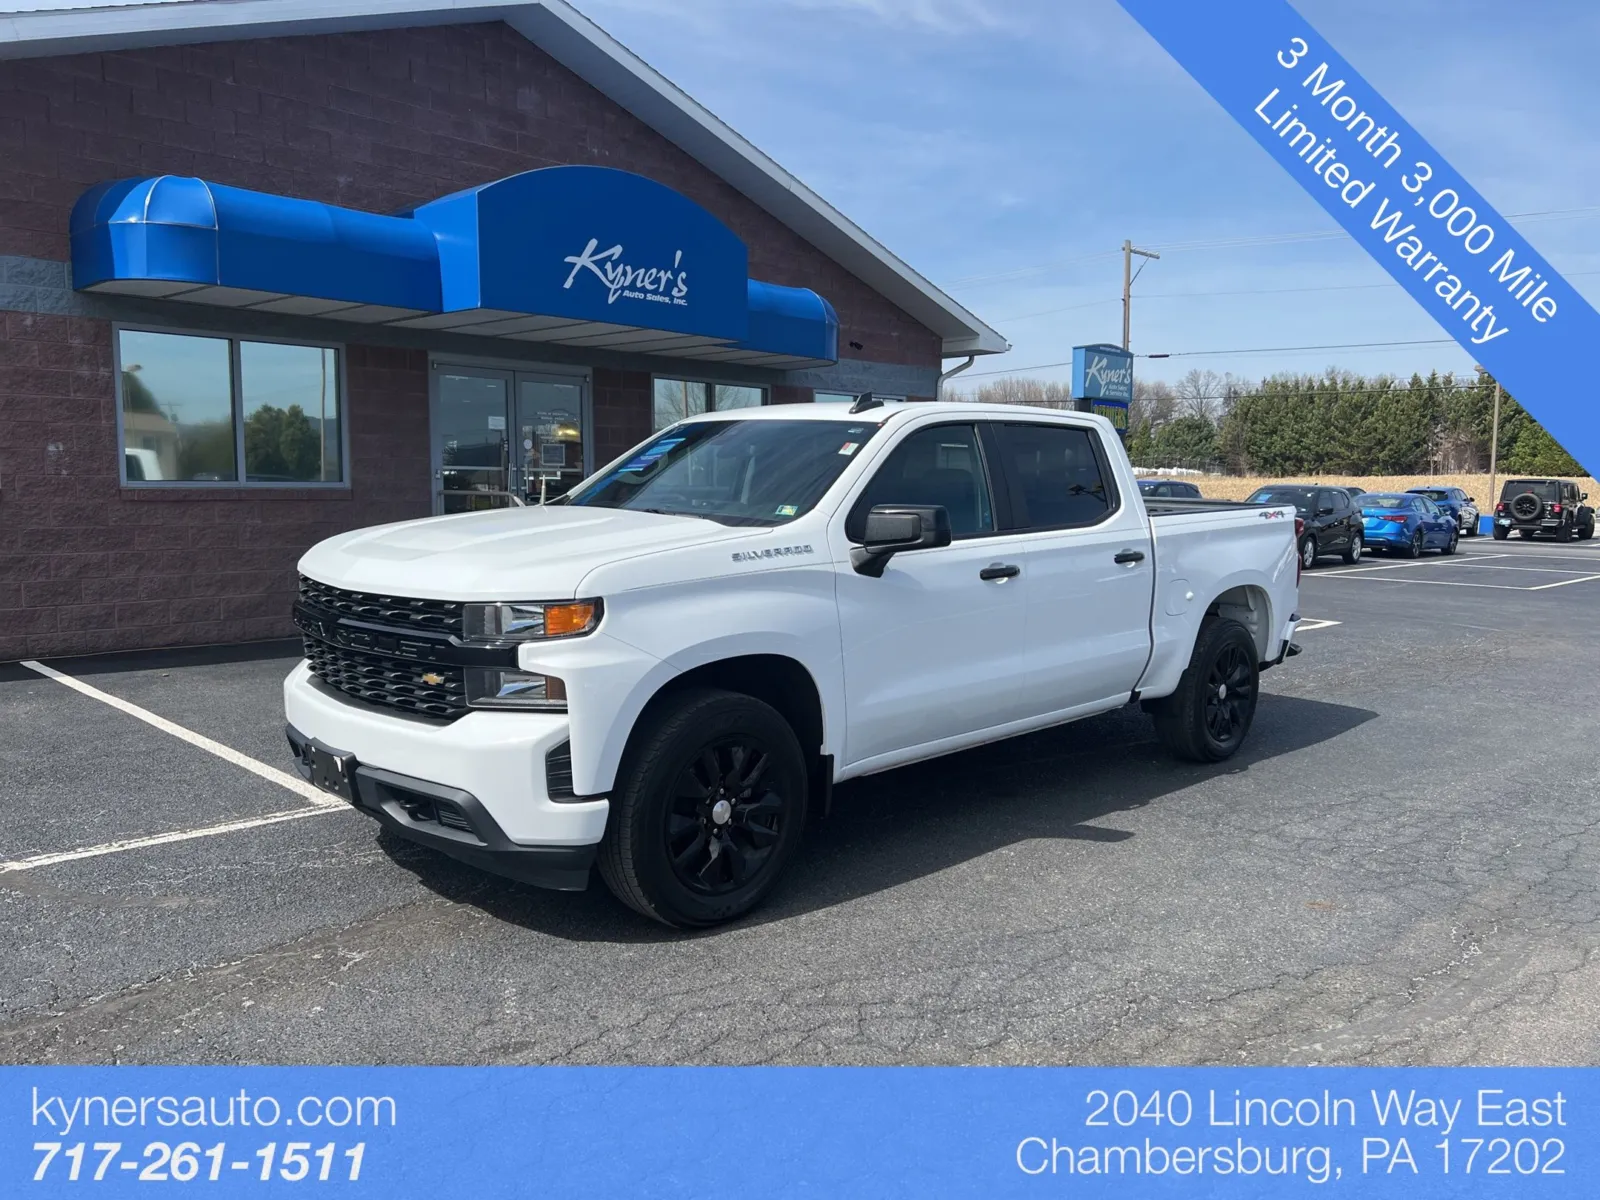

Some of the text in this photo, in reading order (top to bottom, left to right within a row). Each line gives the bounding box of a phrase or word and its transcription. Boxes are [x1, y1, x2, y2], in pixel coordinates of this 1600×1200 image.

[563, 238, 688, 304] Kyner's
[623, 291, 688, 306] Auto Sales, Inc.
[1085, 355, 1131, 397] Kyner's
[732, 545, 814, 562] SILVERADO
